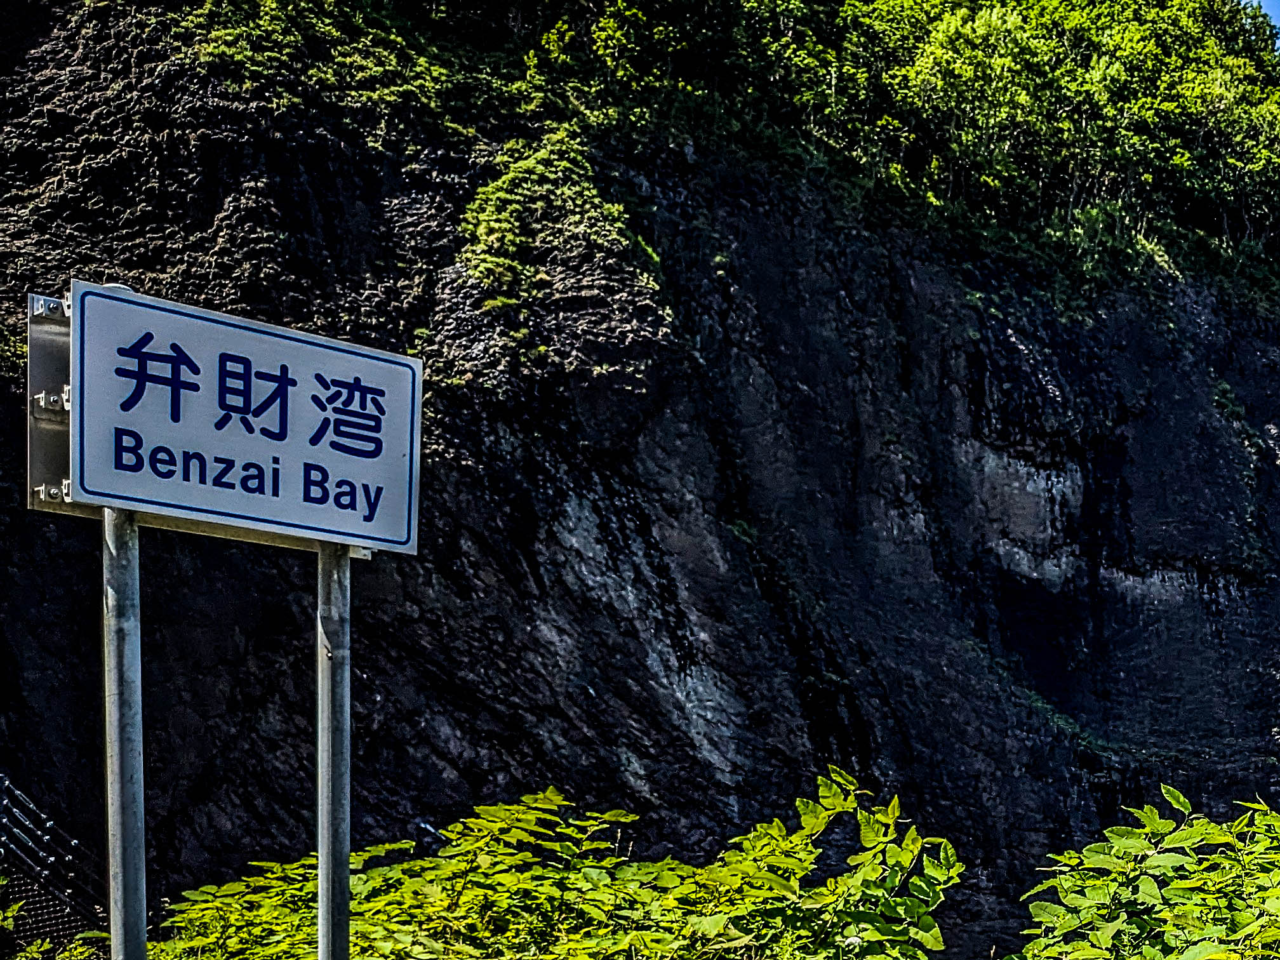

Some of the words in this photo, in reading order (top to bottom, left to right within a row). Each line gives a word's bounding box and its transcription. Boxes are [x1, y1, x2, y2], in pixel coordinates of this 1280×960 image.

[114, 331, 387, 460] 弁財湾
[113, 427, 281, 498] Benzai
[302, 462, 384, 522] Bay
